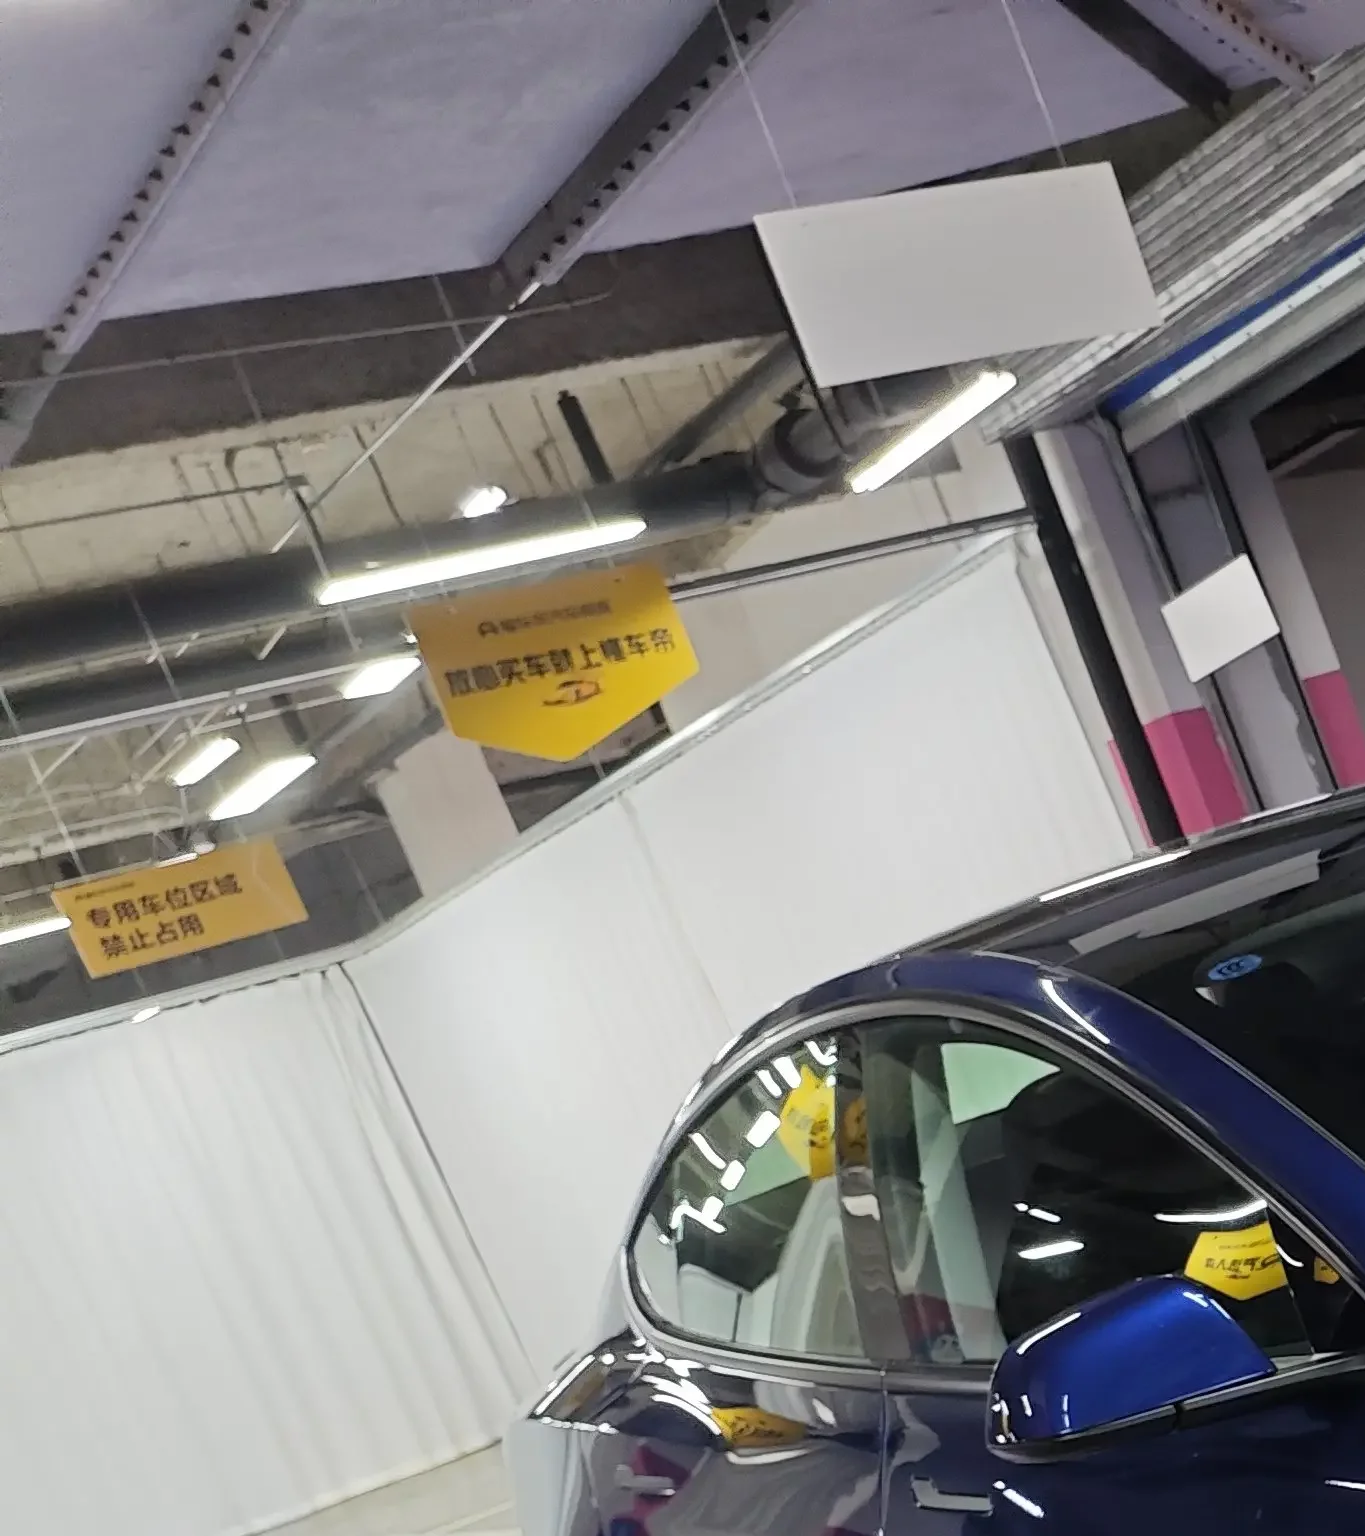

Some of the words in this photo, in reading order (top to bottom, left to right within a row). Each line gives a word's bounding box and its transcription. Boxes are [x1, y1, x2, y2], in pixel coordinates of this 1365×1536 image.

[86, 873, 243, 929] 专用车位区域
[100, 913, 205, 960] 禁止占用
